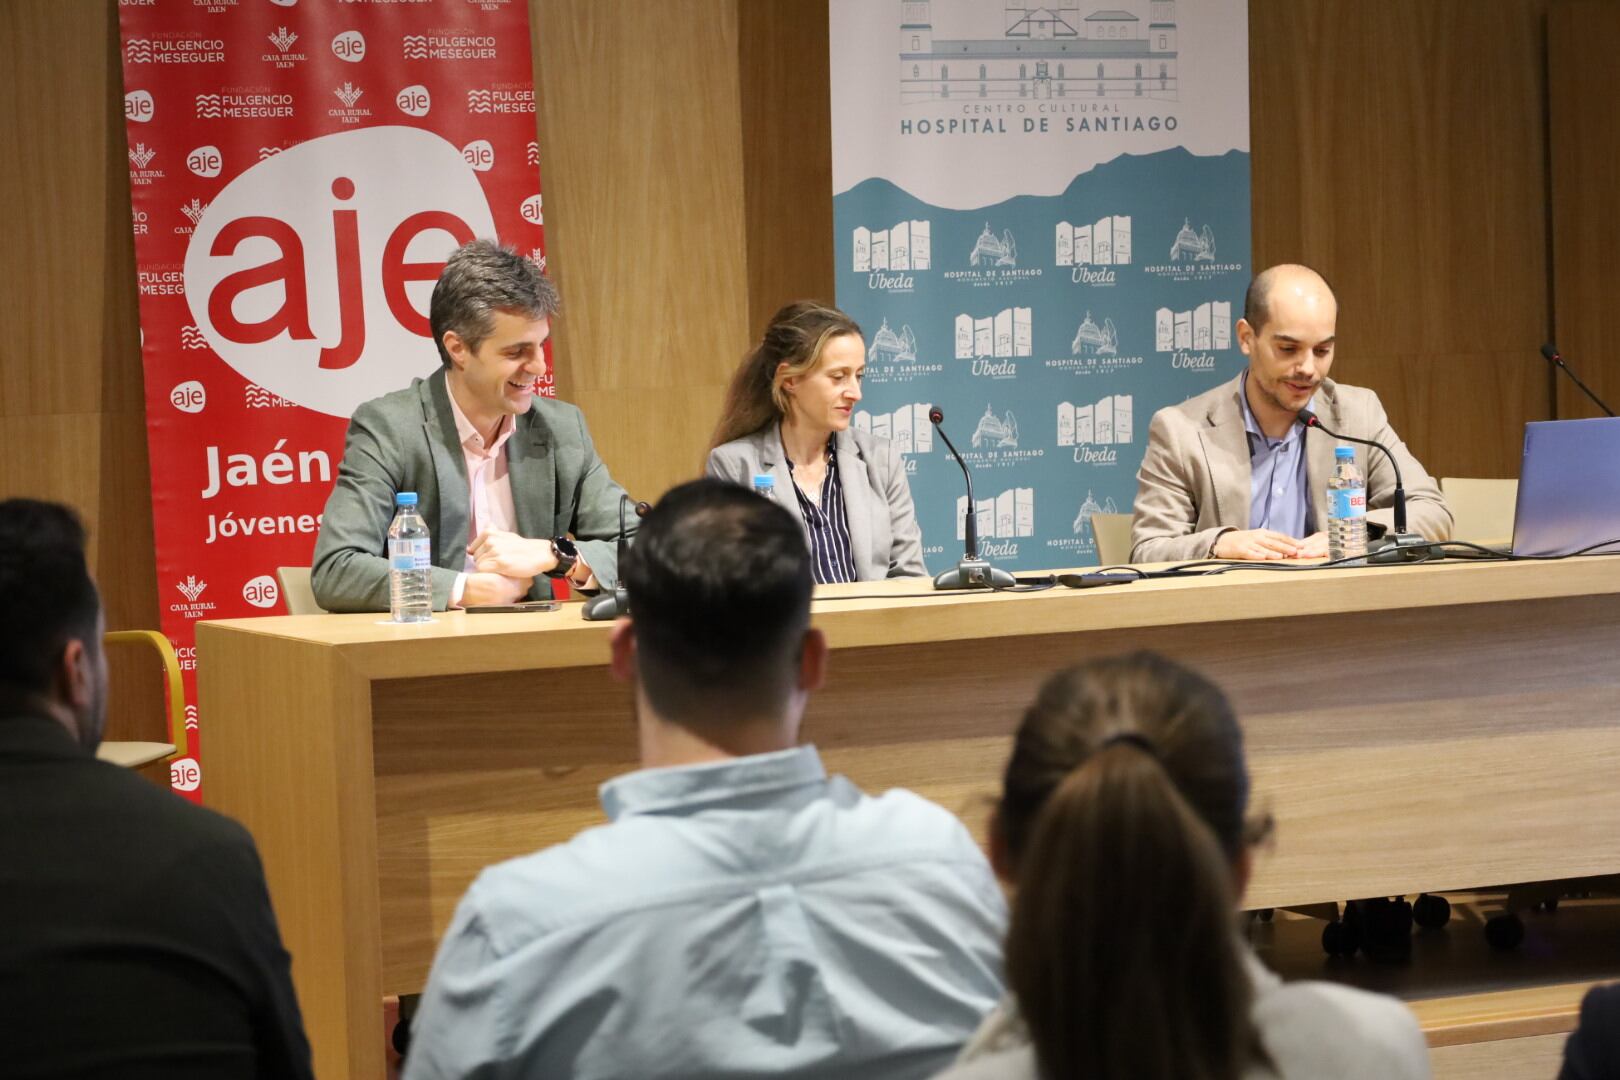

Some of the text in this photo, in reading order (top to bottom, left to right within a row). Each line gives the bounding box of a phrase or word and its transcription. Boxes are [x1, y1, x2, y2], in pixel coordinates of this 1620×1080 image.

[153, 39, 224, 51] FULGENCIO
[334, 36, 364, 57] aje
[428, 36, 496, 47] FULGENCIO
[153, 52, 225, 63] MESEGUER
[429, 48, 497, 60] MESEGUER
[125, 97, 151, 117] aje
[222, 95, 293, 106] FULGENCIO
[399, 92, 428, 111] aje
[962, 102, 1121, 115] CENTRO CULTURAL
[223, 106, 294, 118] MESEGUER
[901, 115, 1179, 135] HOSPITAL DE SANTIAGO
[189, 152, 219, 172] aje
[464, 146, 491, 166] aje
[523, 200, 543, 220] aj
[208, 176, 477, 370] aje
[944, 271, 981, 279] HOSPITAL
[1001, 268, 1043, 277] SANTIAGO
[1071, 264, 1116, 283] Úbeda
[1144, 265, 1182, 273] HOSPITAL
[1200, 263, 1242, 271] SANTIAGO
[868, 267, 914, 289] Úbeda
[971, 355, 1016, 376] Úbeda
[1045, 359, 1083, 367] HOSPITAL
[1102, 357, 1144, 365] SANTIAGO
[1171, 348, 1215, 369] Úbeda
[900, 364, 943, 373] SANTIAGO
[173, 387, 203, 408] aje
[1003, 449, 1044, 458] SANTIAGO
[1073, 442, 1117, 463] Úbeda
[202, 438, 331, 499] Jaén
[1046, 538, 1084, 546] HOSPITAL
[246, 582, 275, 603] aje
[190, 602, 217, 610] RURAL
[171, 765, 198, 786] aje
